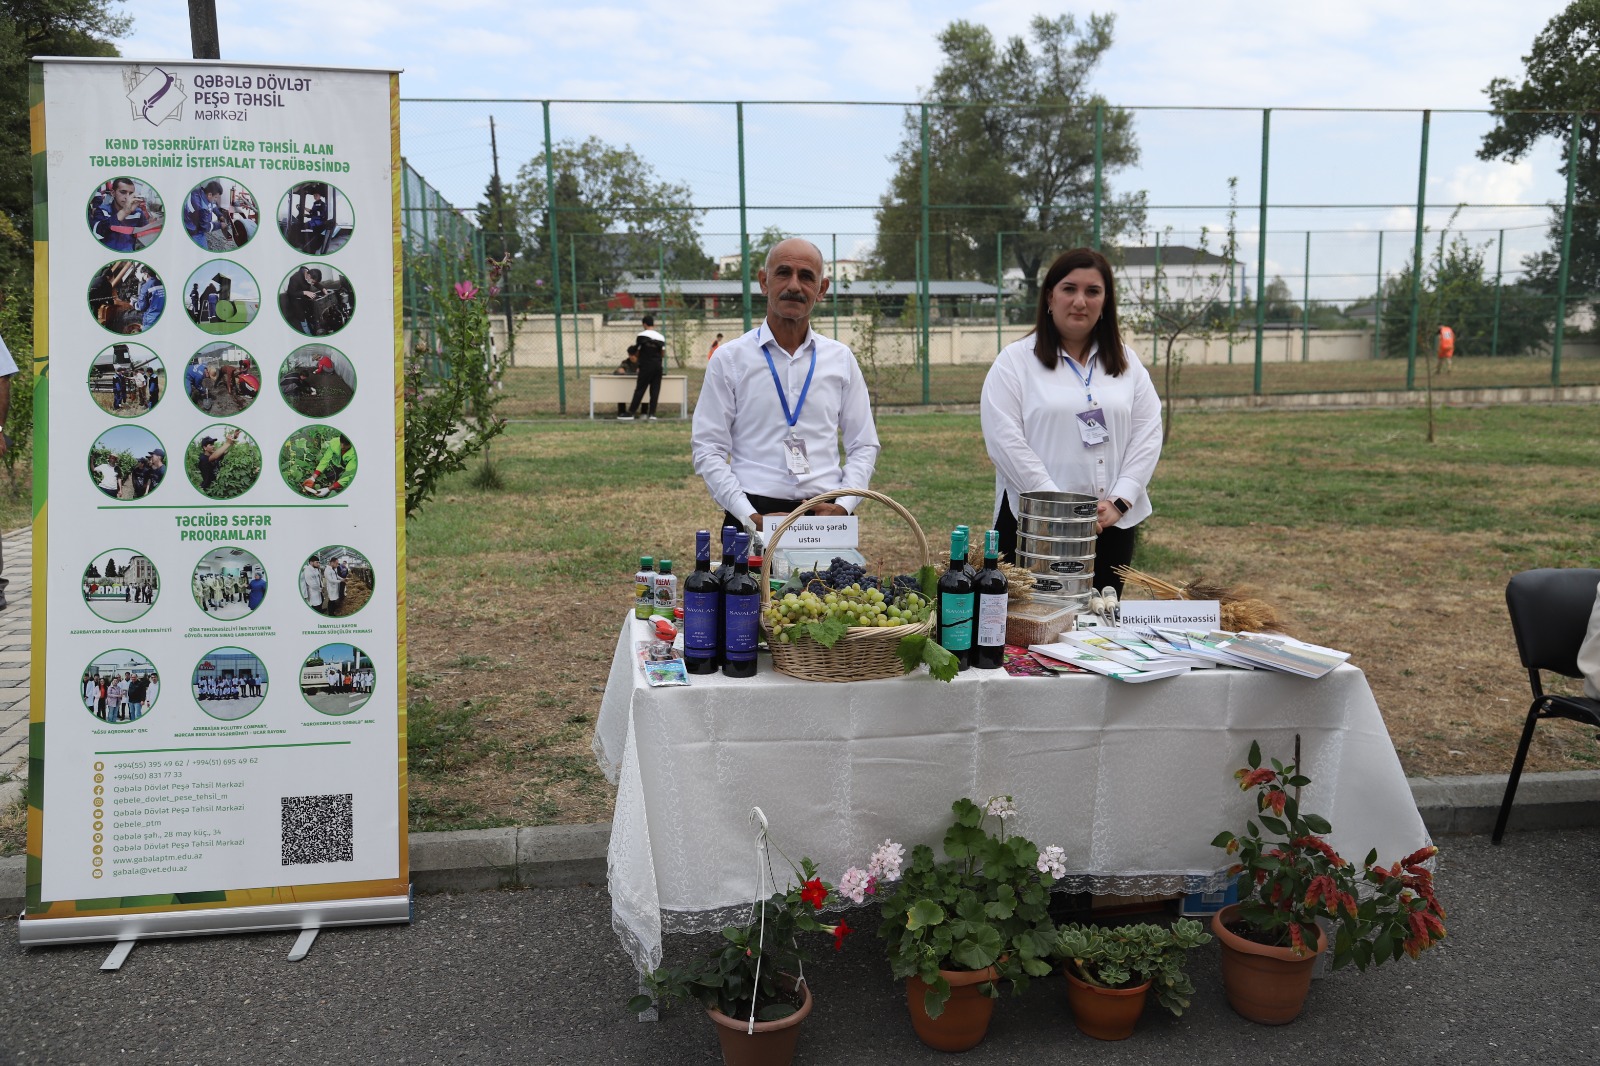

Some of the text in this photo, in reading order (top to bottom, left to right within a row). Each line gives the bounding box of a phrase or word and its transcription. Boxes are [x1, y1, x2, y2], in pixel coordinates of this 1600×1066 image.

[194, 74, 312, 91] QƏBƏLƏ DÖVLƏT
[194, 91, 284, 108] PEŞƏ TƏHSİL
[194, 108, 247, 121] MƏRKƏZİ
[106, 136, 334, 155] KƏND TƏSƏRRÜFATI ÜZRƏ TƏHSİL ALAN
[89, 153, 350, 173] TƏLƏBƏLƏRİMİZ İSTEHSALAT TƏCRÜBƏSİNDƏ
[175, 512, 272, 527] TƏCRÜBƏ SƏFƏR
[771, 523, 813, 532] Ümçülük
[826, 523, 847, 532] şərab
[180, 530, 266, 542] PROQRAMLARI
[1122, 614, 1216, 625] Bitkiçilik mütəxəssisi
[113, 853, 202, 864] www.gabalaptm.edu.az
[113, 865, 187, 877] gabala@vet.edu.az
